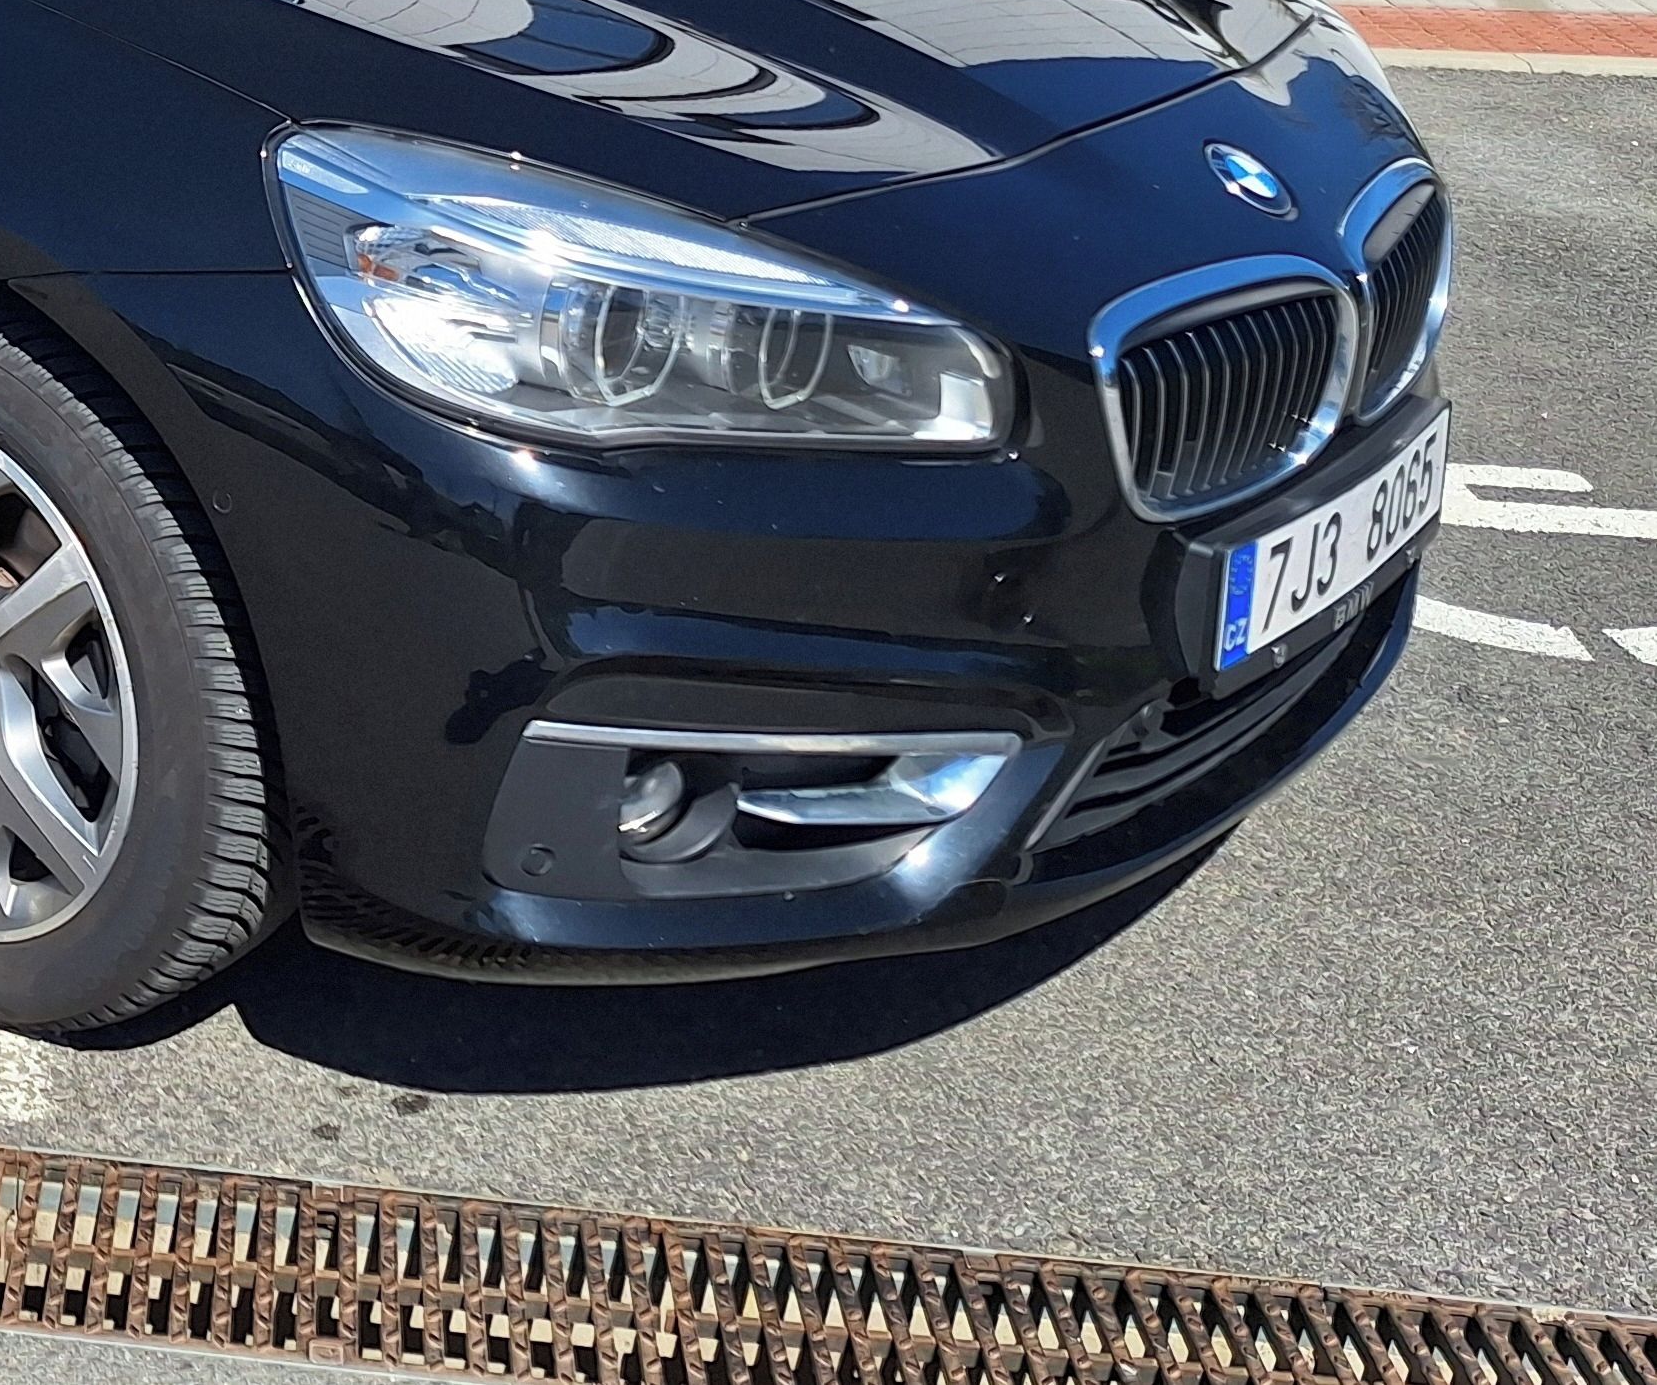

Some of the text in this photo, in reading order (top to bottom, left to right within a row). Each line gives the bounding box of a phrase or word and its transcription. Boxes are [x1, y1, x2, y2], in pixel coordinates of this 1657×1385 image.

[1261, 430, 1438, 633] 7J3 8065
[1223, 617, 1248, 651] CZ
